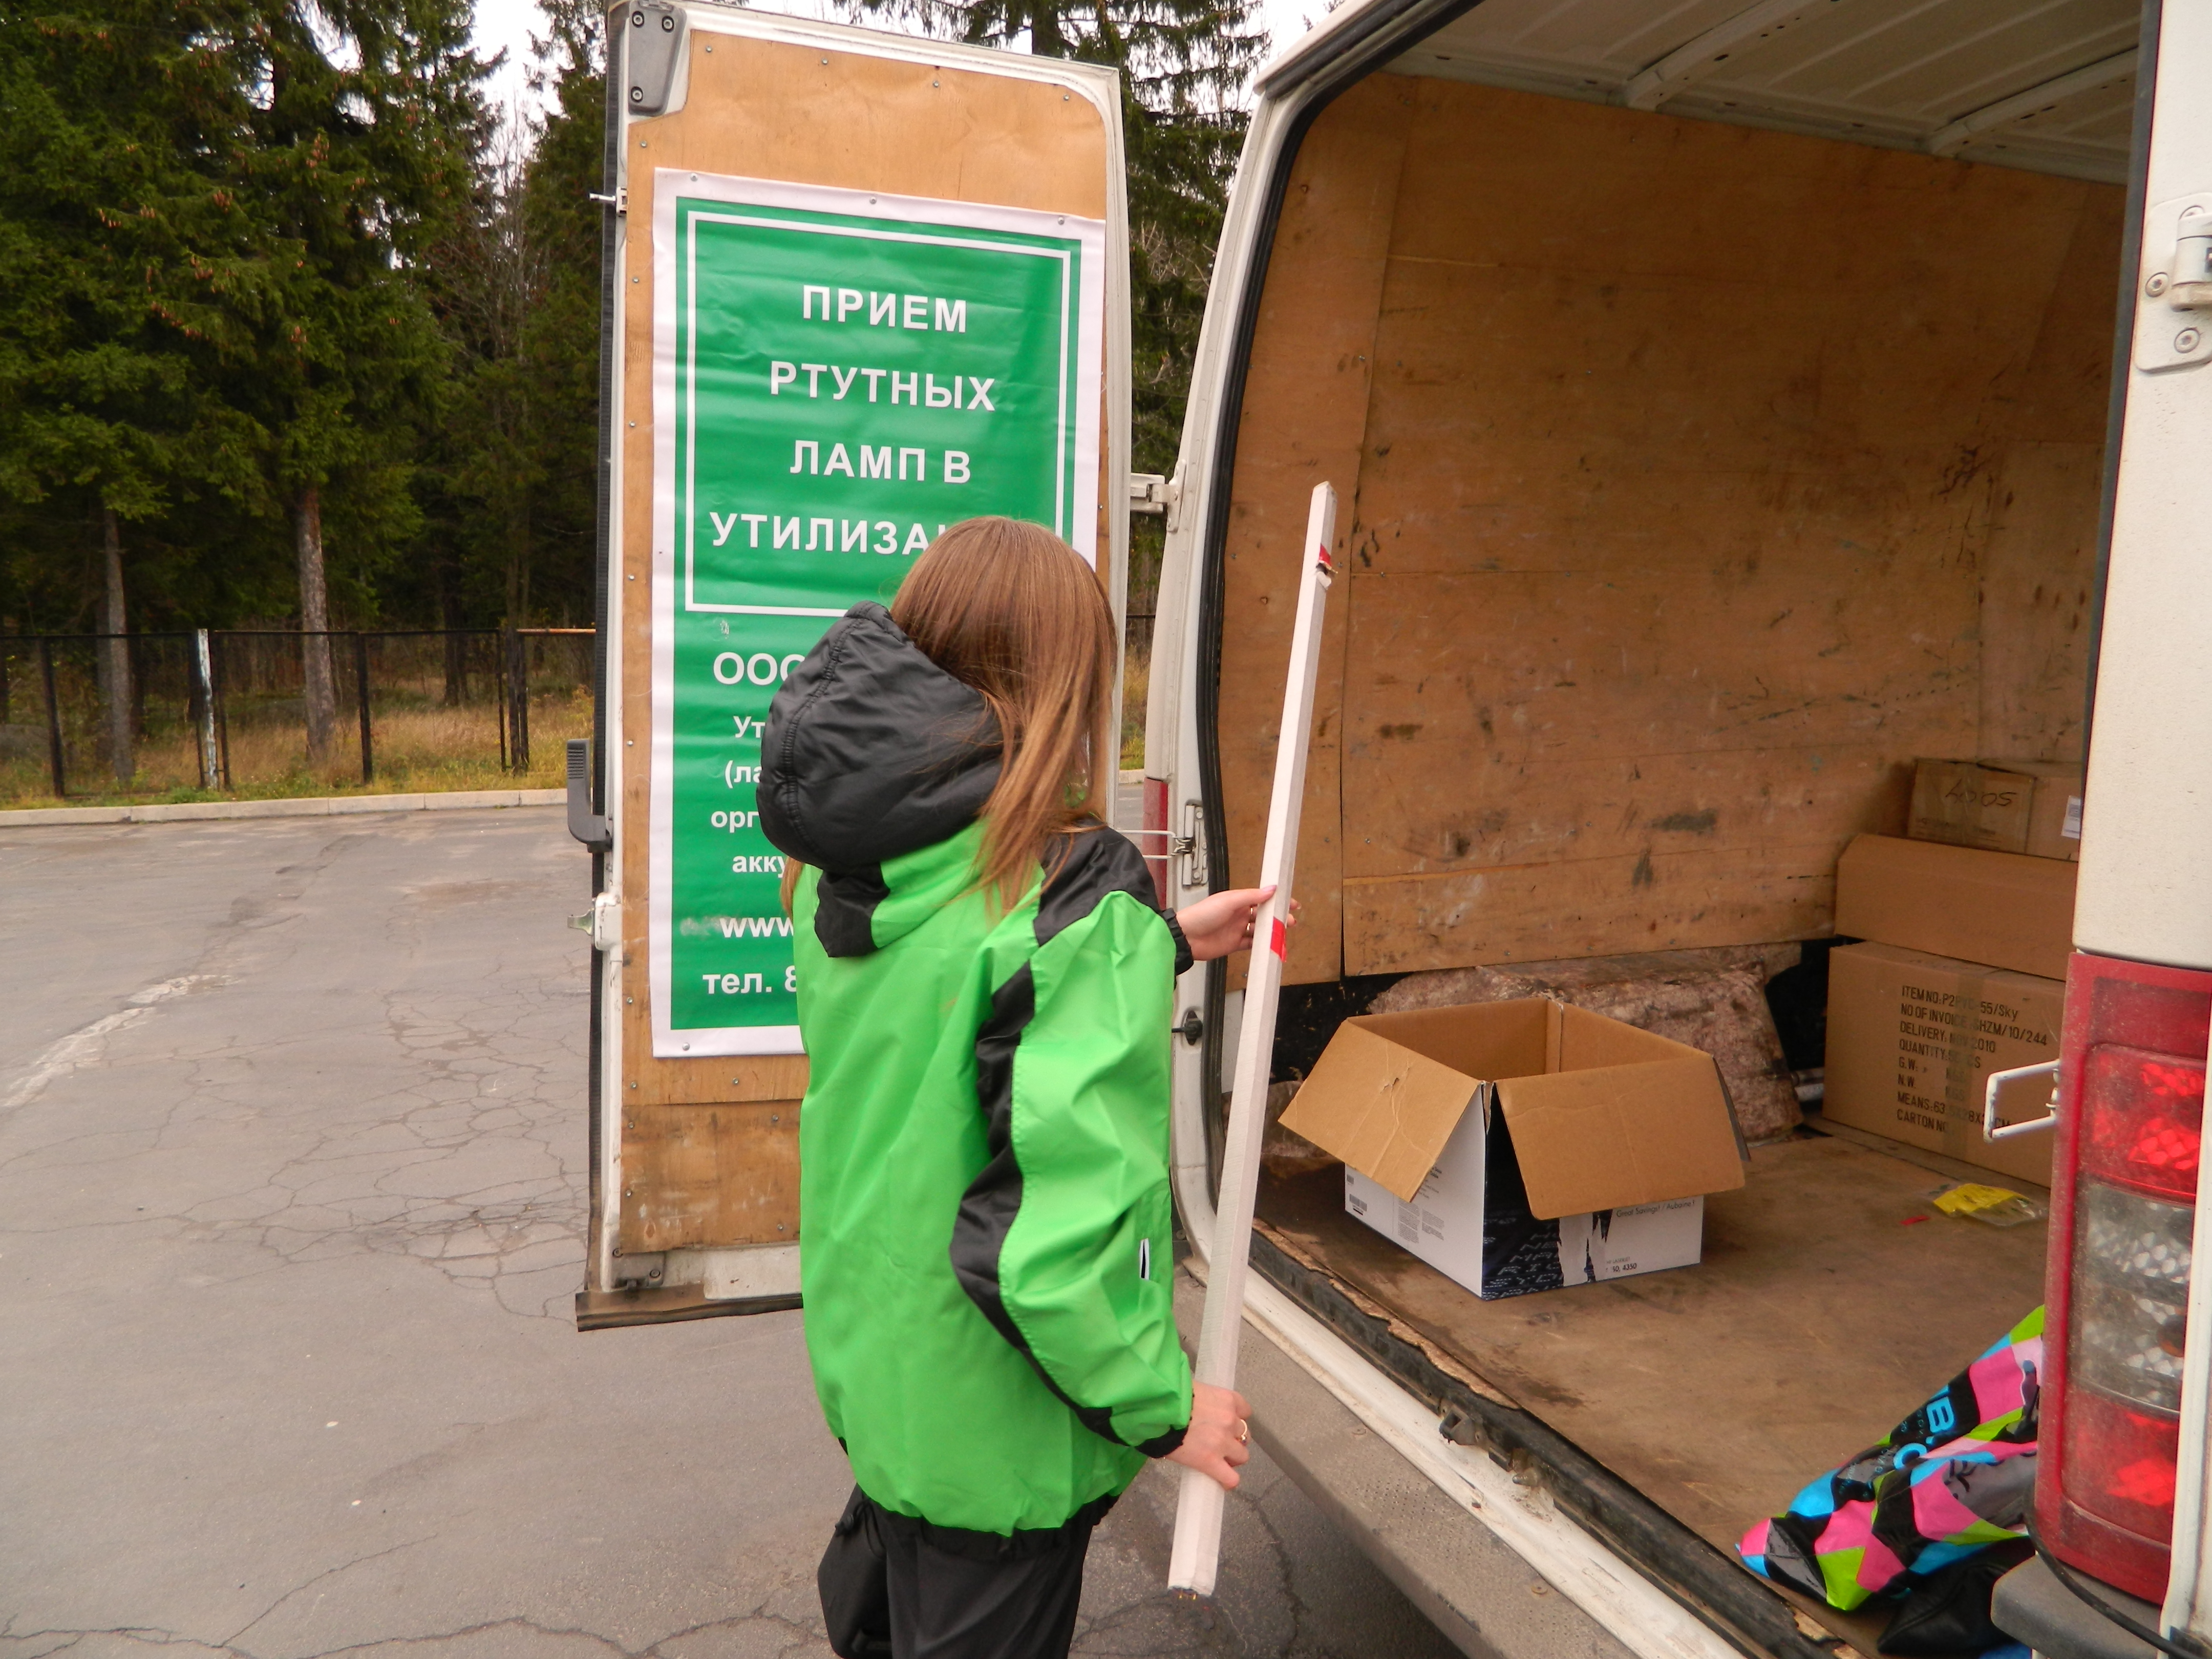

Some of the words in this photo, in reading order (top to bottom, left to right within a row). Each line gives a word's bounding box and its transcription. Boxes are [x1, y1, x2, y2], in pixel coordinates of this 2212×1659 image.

[802, 284, 967, 333] ПРИЕМ
[770, 360, 995, 411] РТУТНЫХ
[790, 439, 925, 481] ЛАМП
[944, 450, 971, 483] В
[709, 512, 946, 555] УТИЛИЗА
[702, 972, 772, 994] тел.
[1902, 985, 1924, 1000] ITEM
[1901, 1003, 1913, 1016] NO
[1915, 1006, 1928, 1019] OF
[1896, 1108, 1934, 1130] CARTON
[1616, 1209, 1634, 1218] Great
[1622, 1262, 1637, 1270] 4350
